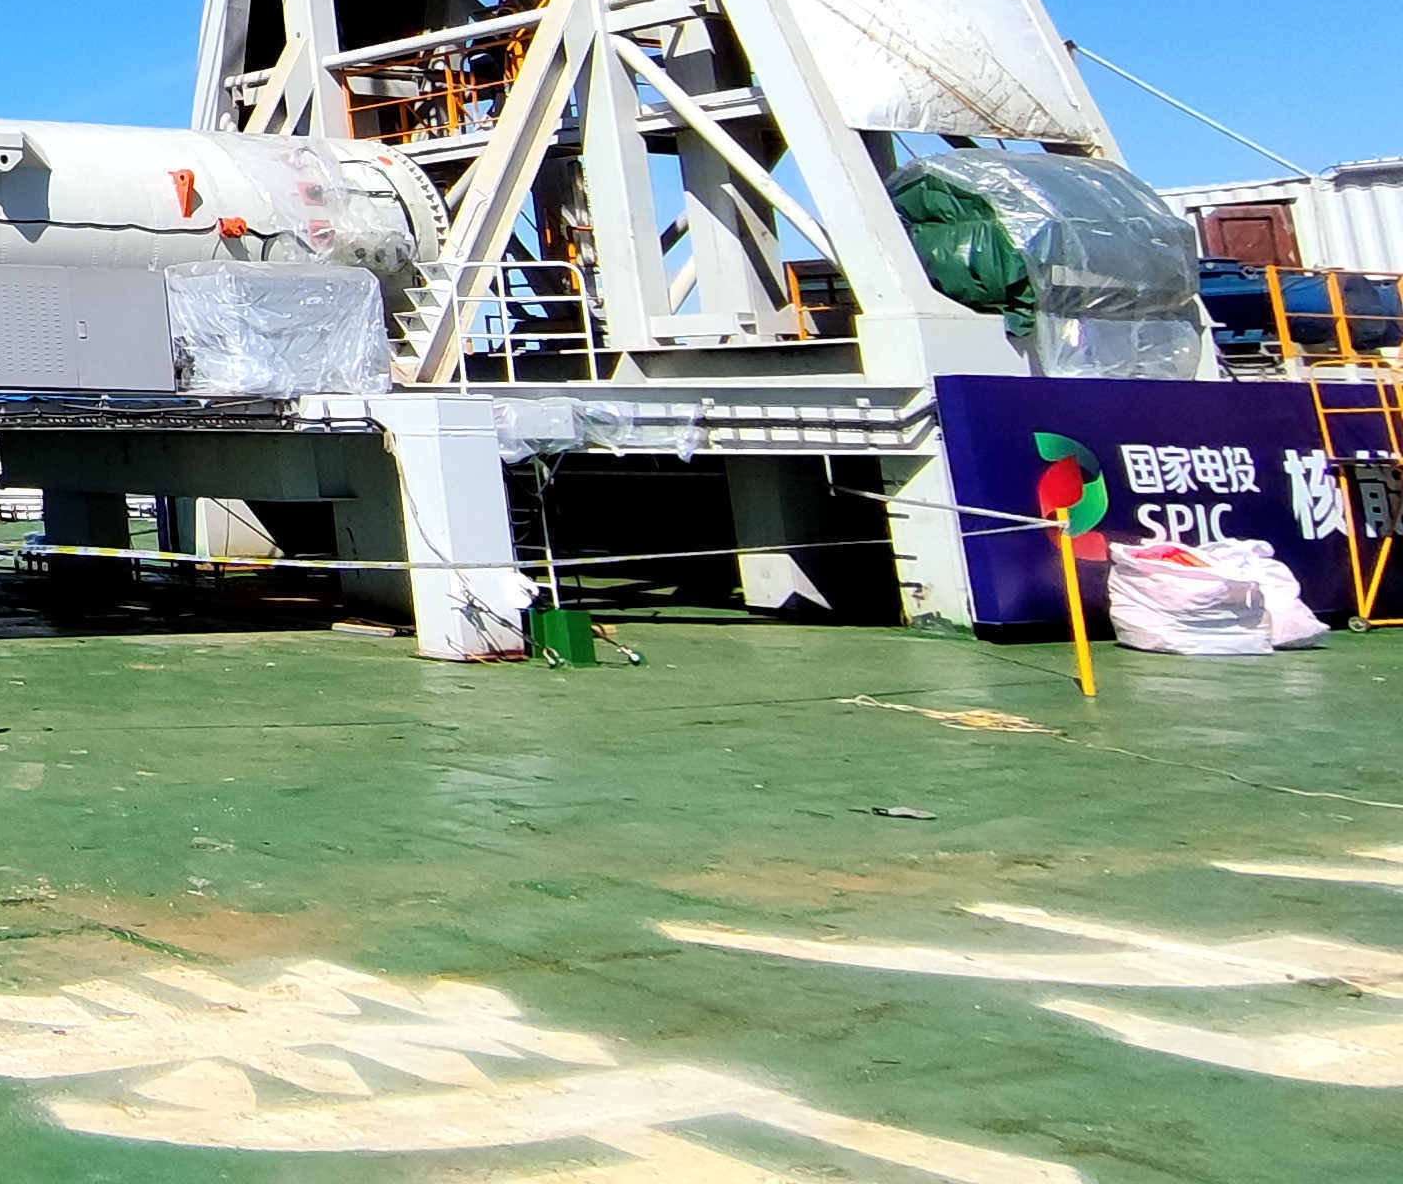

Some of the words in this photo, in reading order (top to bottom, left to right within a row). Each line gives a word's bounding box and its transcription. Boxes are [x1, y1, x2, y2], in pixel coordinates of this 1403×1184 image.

[1119, 444, 1261, 494] 国家电投
[1137, 502, 1233, 544] SPIC
